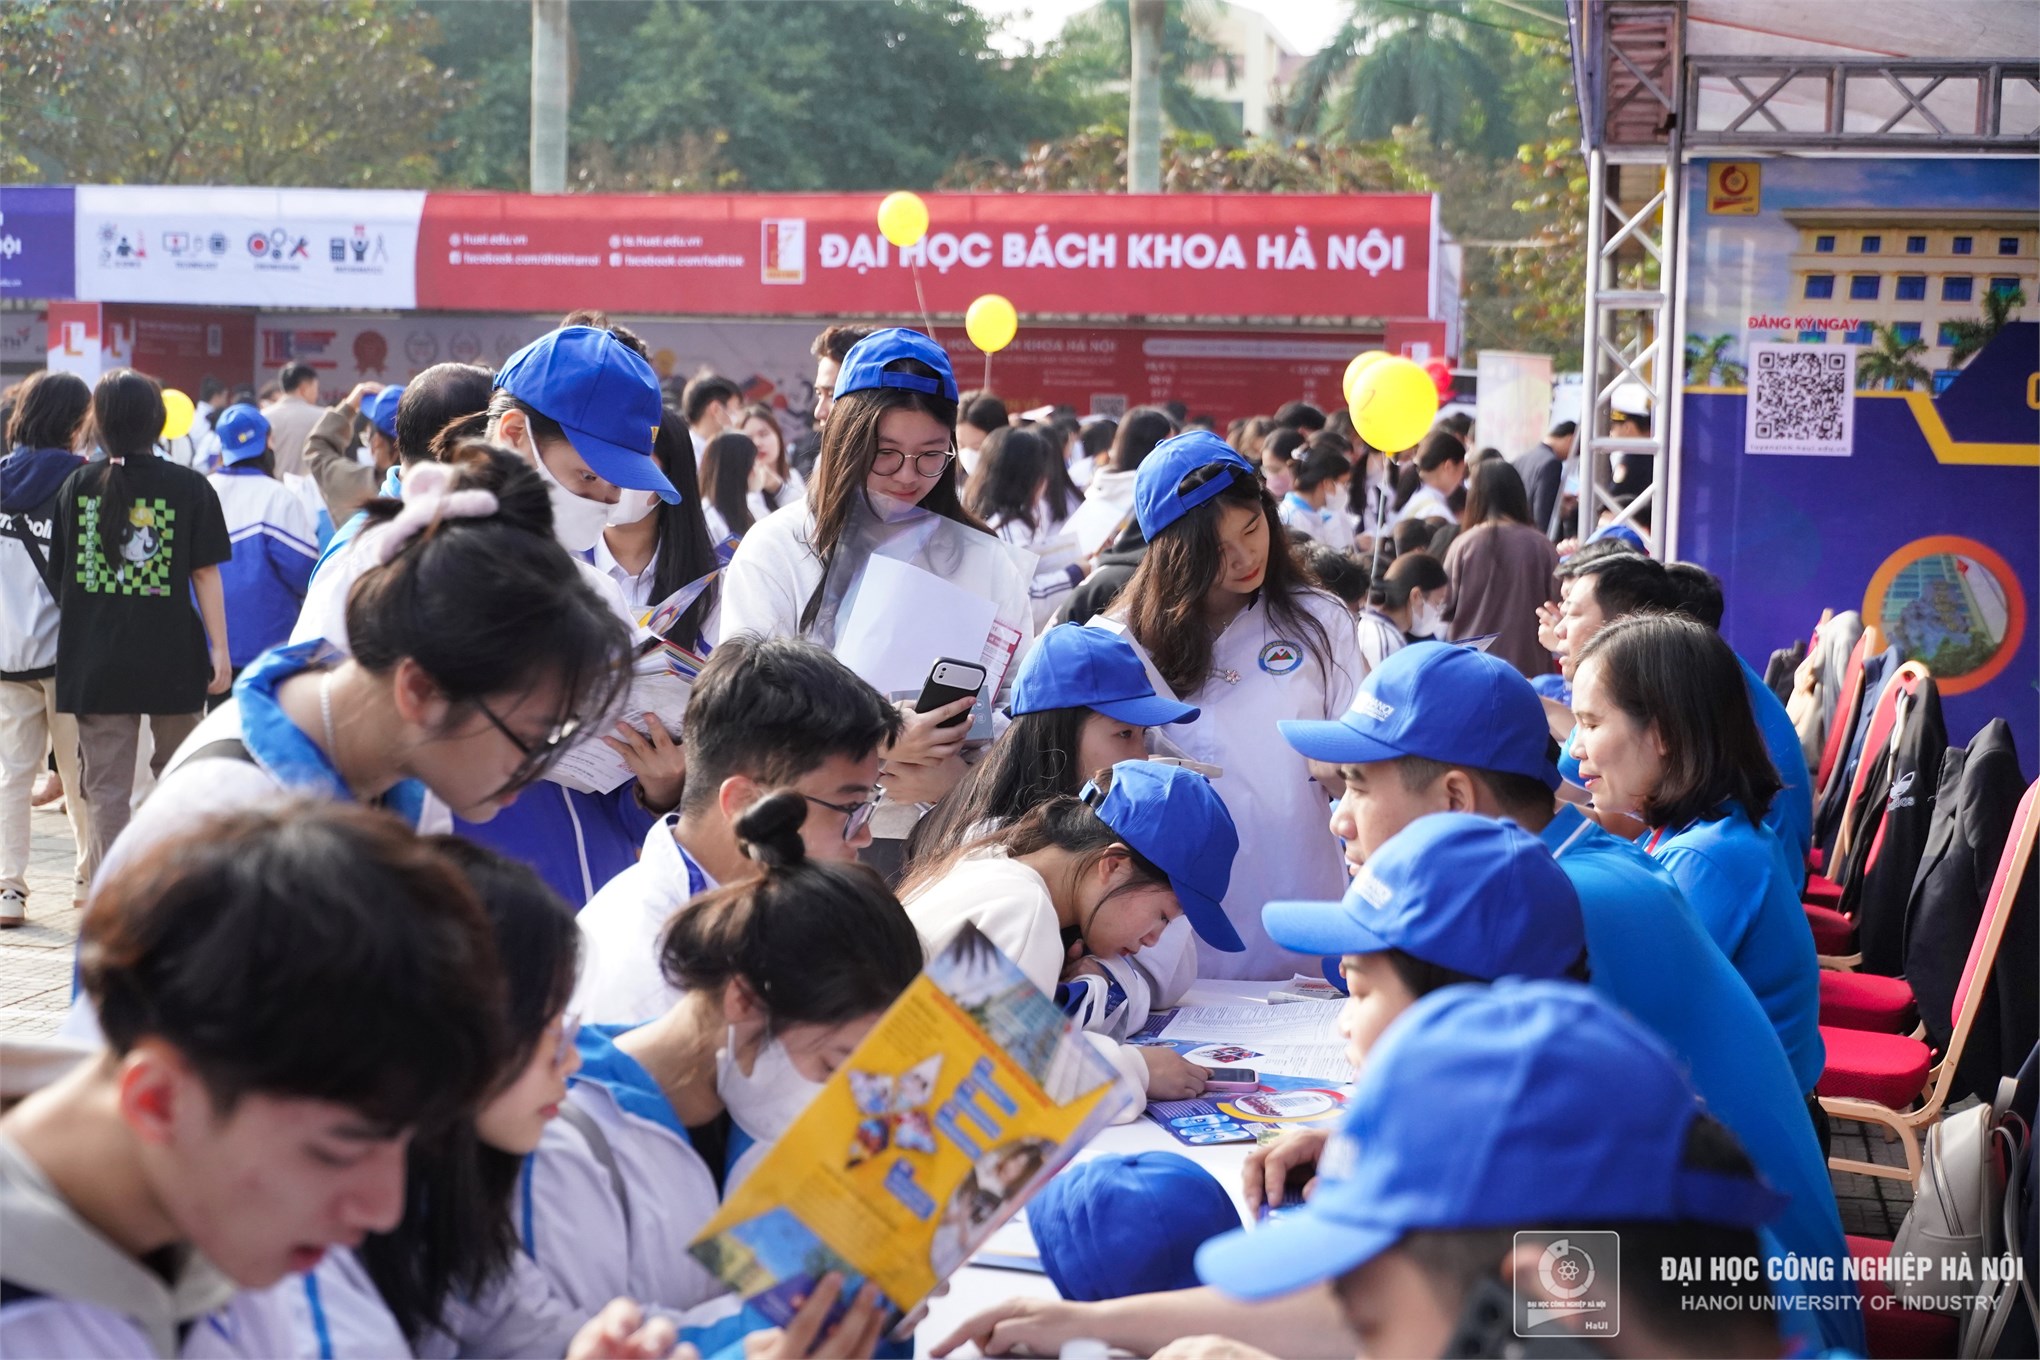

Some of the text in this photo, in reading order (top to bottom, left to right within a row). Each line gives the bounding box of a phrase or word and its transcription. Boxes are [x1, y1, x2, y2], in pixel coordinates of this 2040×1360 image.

[0, 234, 21, 259] ỘI
[819, 224, 1404, 277] ĐẠI HỌC BÁCH KHOA HÀ NỘI
[1748, 314, 1791, 330] ĐĂNG
[1817, 317, 1860, 331] NGAY
